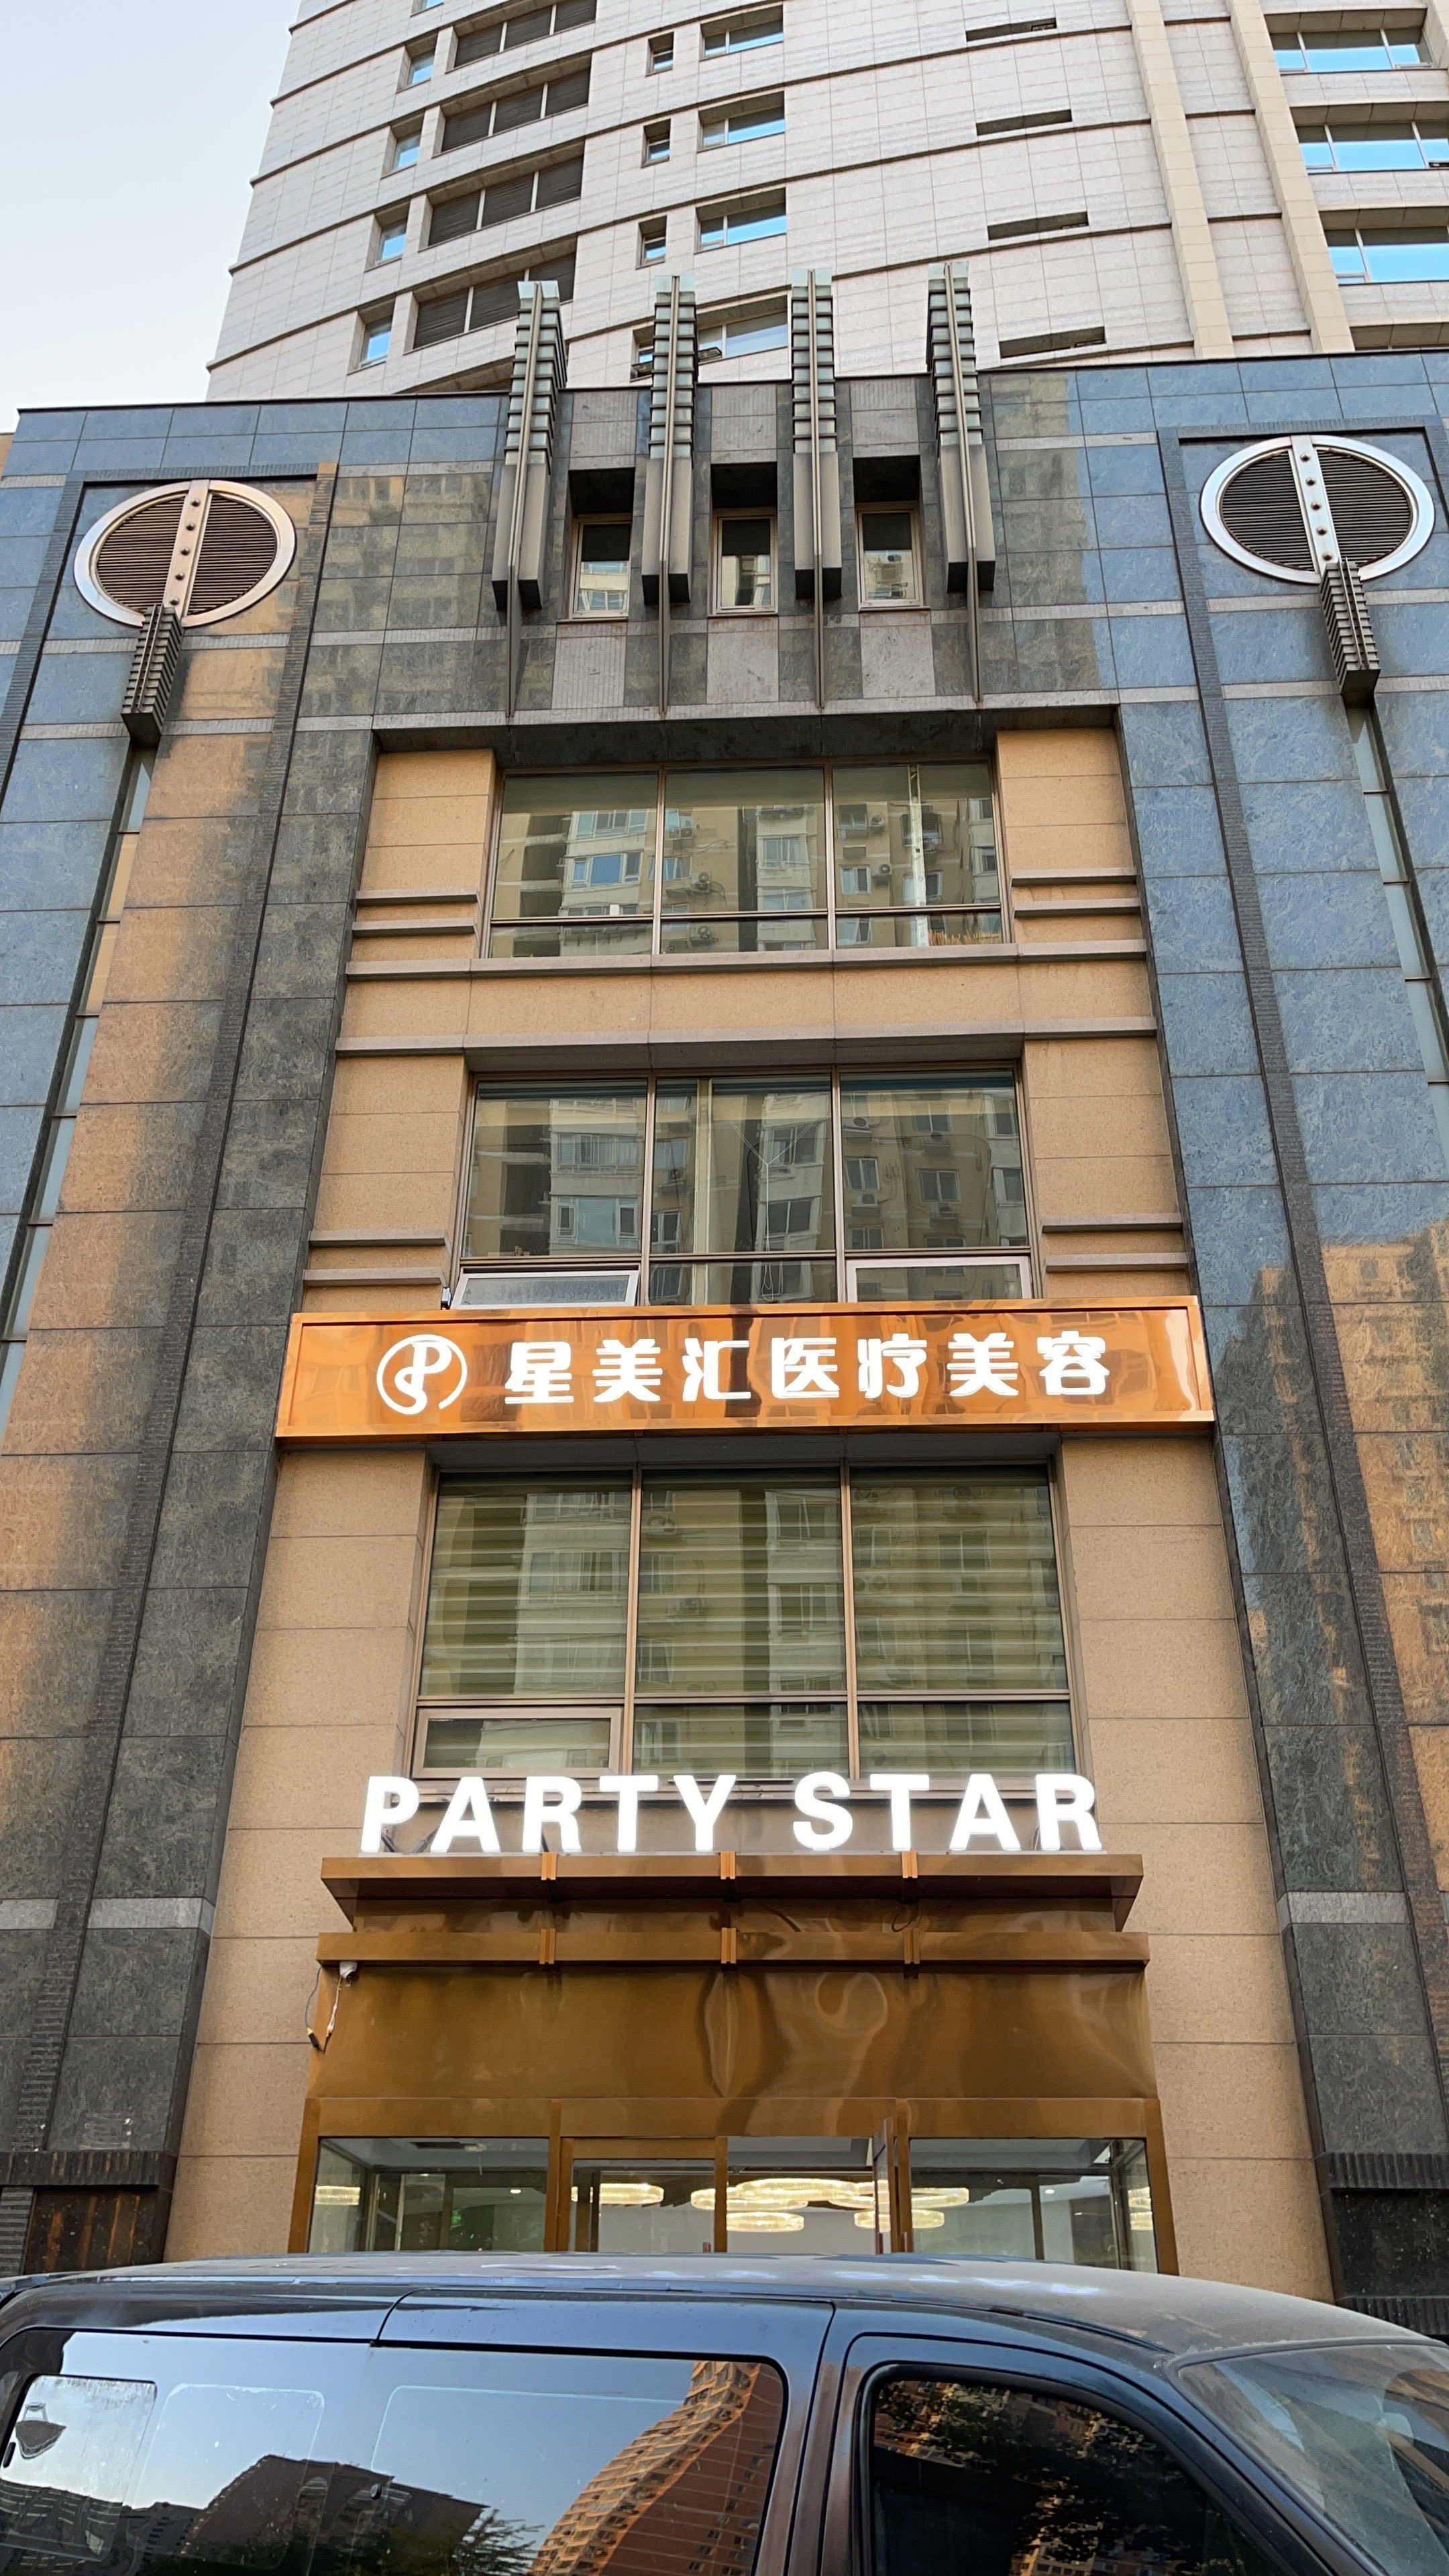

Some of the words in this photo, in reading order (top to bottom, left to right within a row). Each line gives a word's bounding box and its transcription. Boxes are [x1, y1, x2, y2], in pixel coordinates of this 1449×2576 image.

[505, 1331, 1109, 1404] 星美汇医疗美容
[360, 1775, 736, 1853] PARTY
[794, 1771, 1102, 1851] STAR
